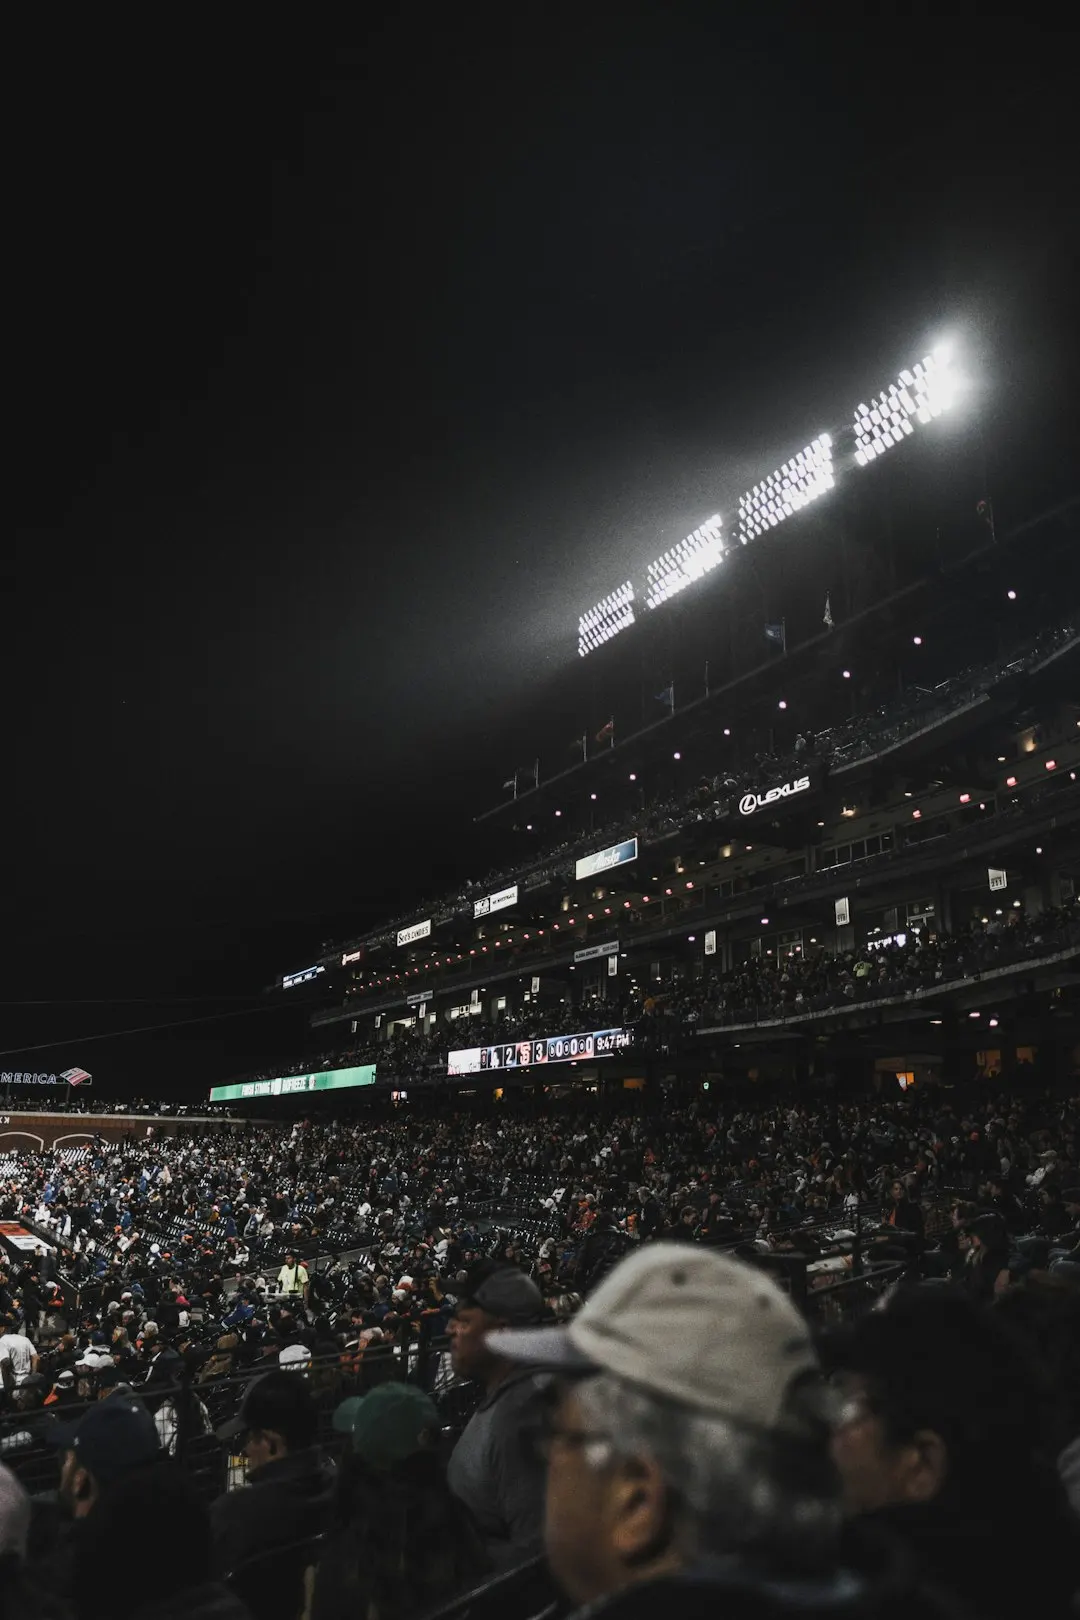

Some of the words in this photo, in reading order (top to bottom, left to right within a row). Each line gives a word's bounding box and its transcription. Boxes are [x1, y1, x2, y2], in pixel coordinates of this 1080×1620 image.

[757, 776, 811, 805] LEXUS
[594, 849, 621, 869] Alaska
[398, 931, 411, 944] See's
[411, 926, 429, 939] CANDIES
[505, 1047, 513, 1065] 2
[535, 1042, 543, 1061] 3
[597, 1035, 614, 1051] 9:47
[616, 1034, 630, 1048] PM
